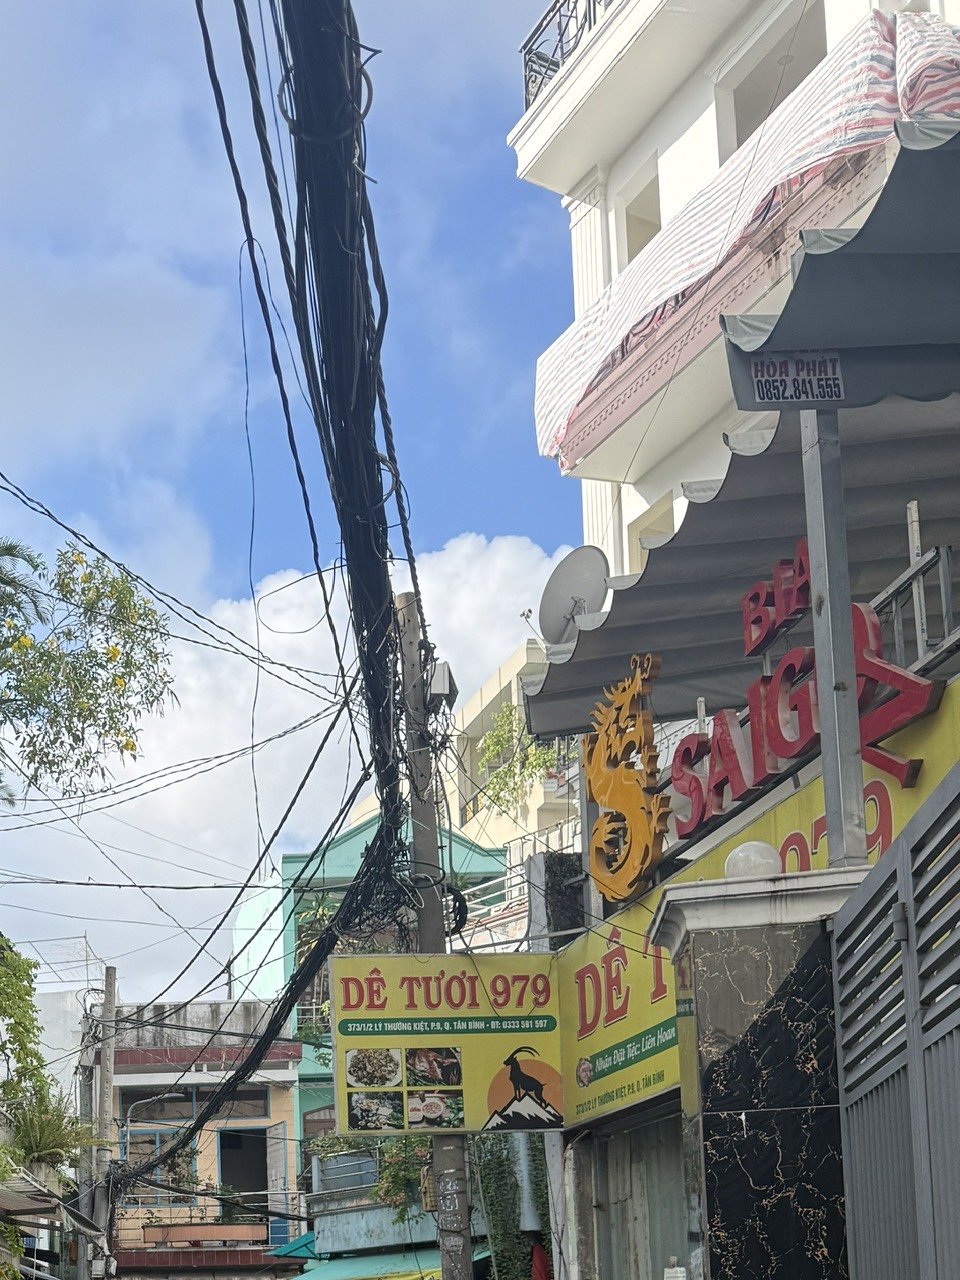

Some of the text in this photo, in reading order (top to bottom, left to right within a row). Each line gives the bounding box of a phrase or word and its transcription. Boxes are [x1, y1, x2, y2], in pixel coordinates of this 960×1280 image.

[753, 356, 838, 379] HÒA PHÁT
[757, 377, 841, 401] 0852.841.555
[340, 967, 551, 1011] DÊ TƯƠI 979
[575, 926, 631, 1041] DÊ
[347, 1023, 373, 1032] 373/1/2
[374, 1021, 382, 1031] LÝ
[384, 1021, 412, 1031] THƯỜNG
[453, 1020, 467, 1030] TÂN
[468, 1020, 485, 1030] BÌNH
[502, 1021, 520, 1029] 0333
[521, 1020, 533, 1028] 591
[534, 1020, 548, 1028] 597
[595, 1054, 612, 1073] Nhận
[613, 1048, 626, 1065] Đặt
[641, 1035, 656, 1052] Liên
[656, 1027, 676, 1047] Hoan
